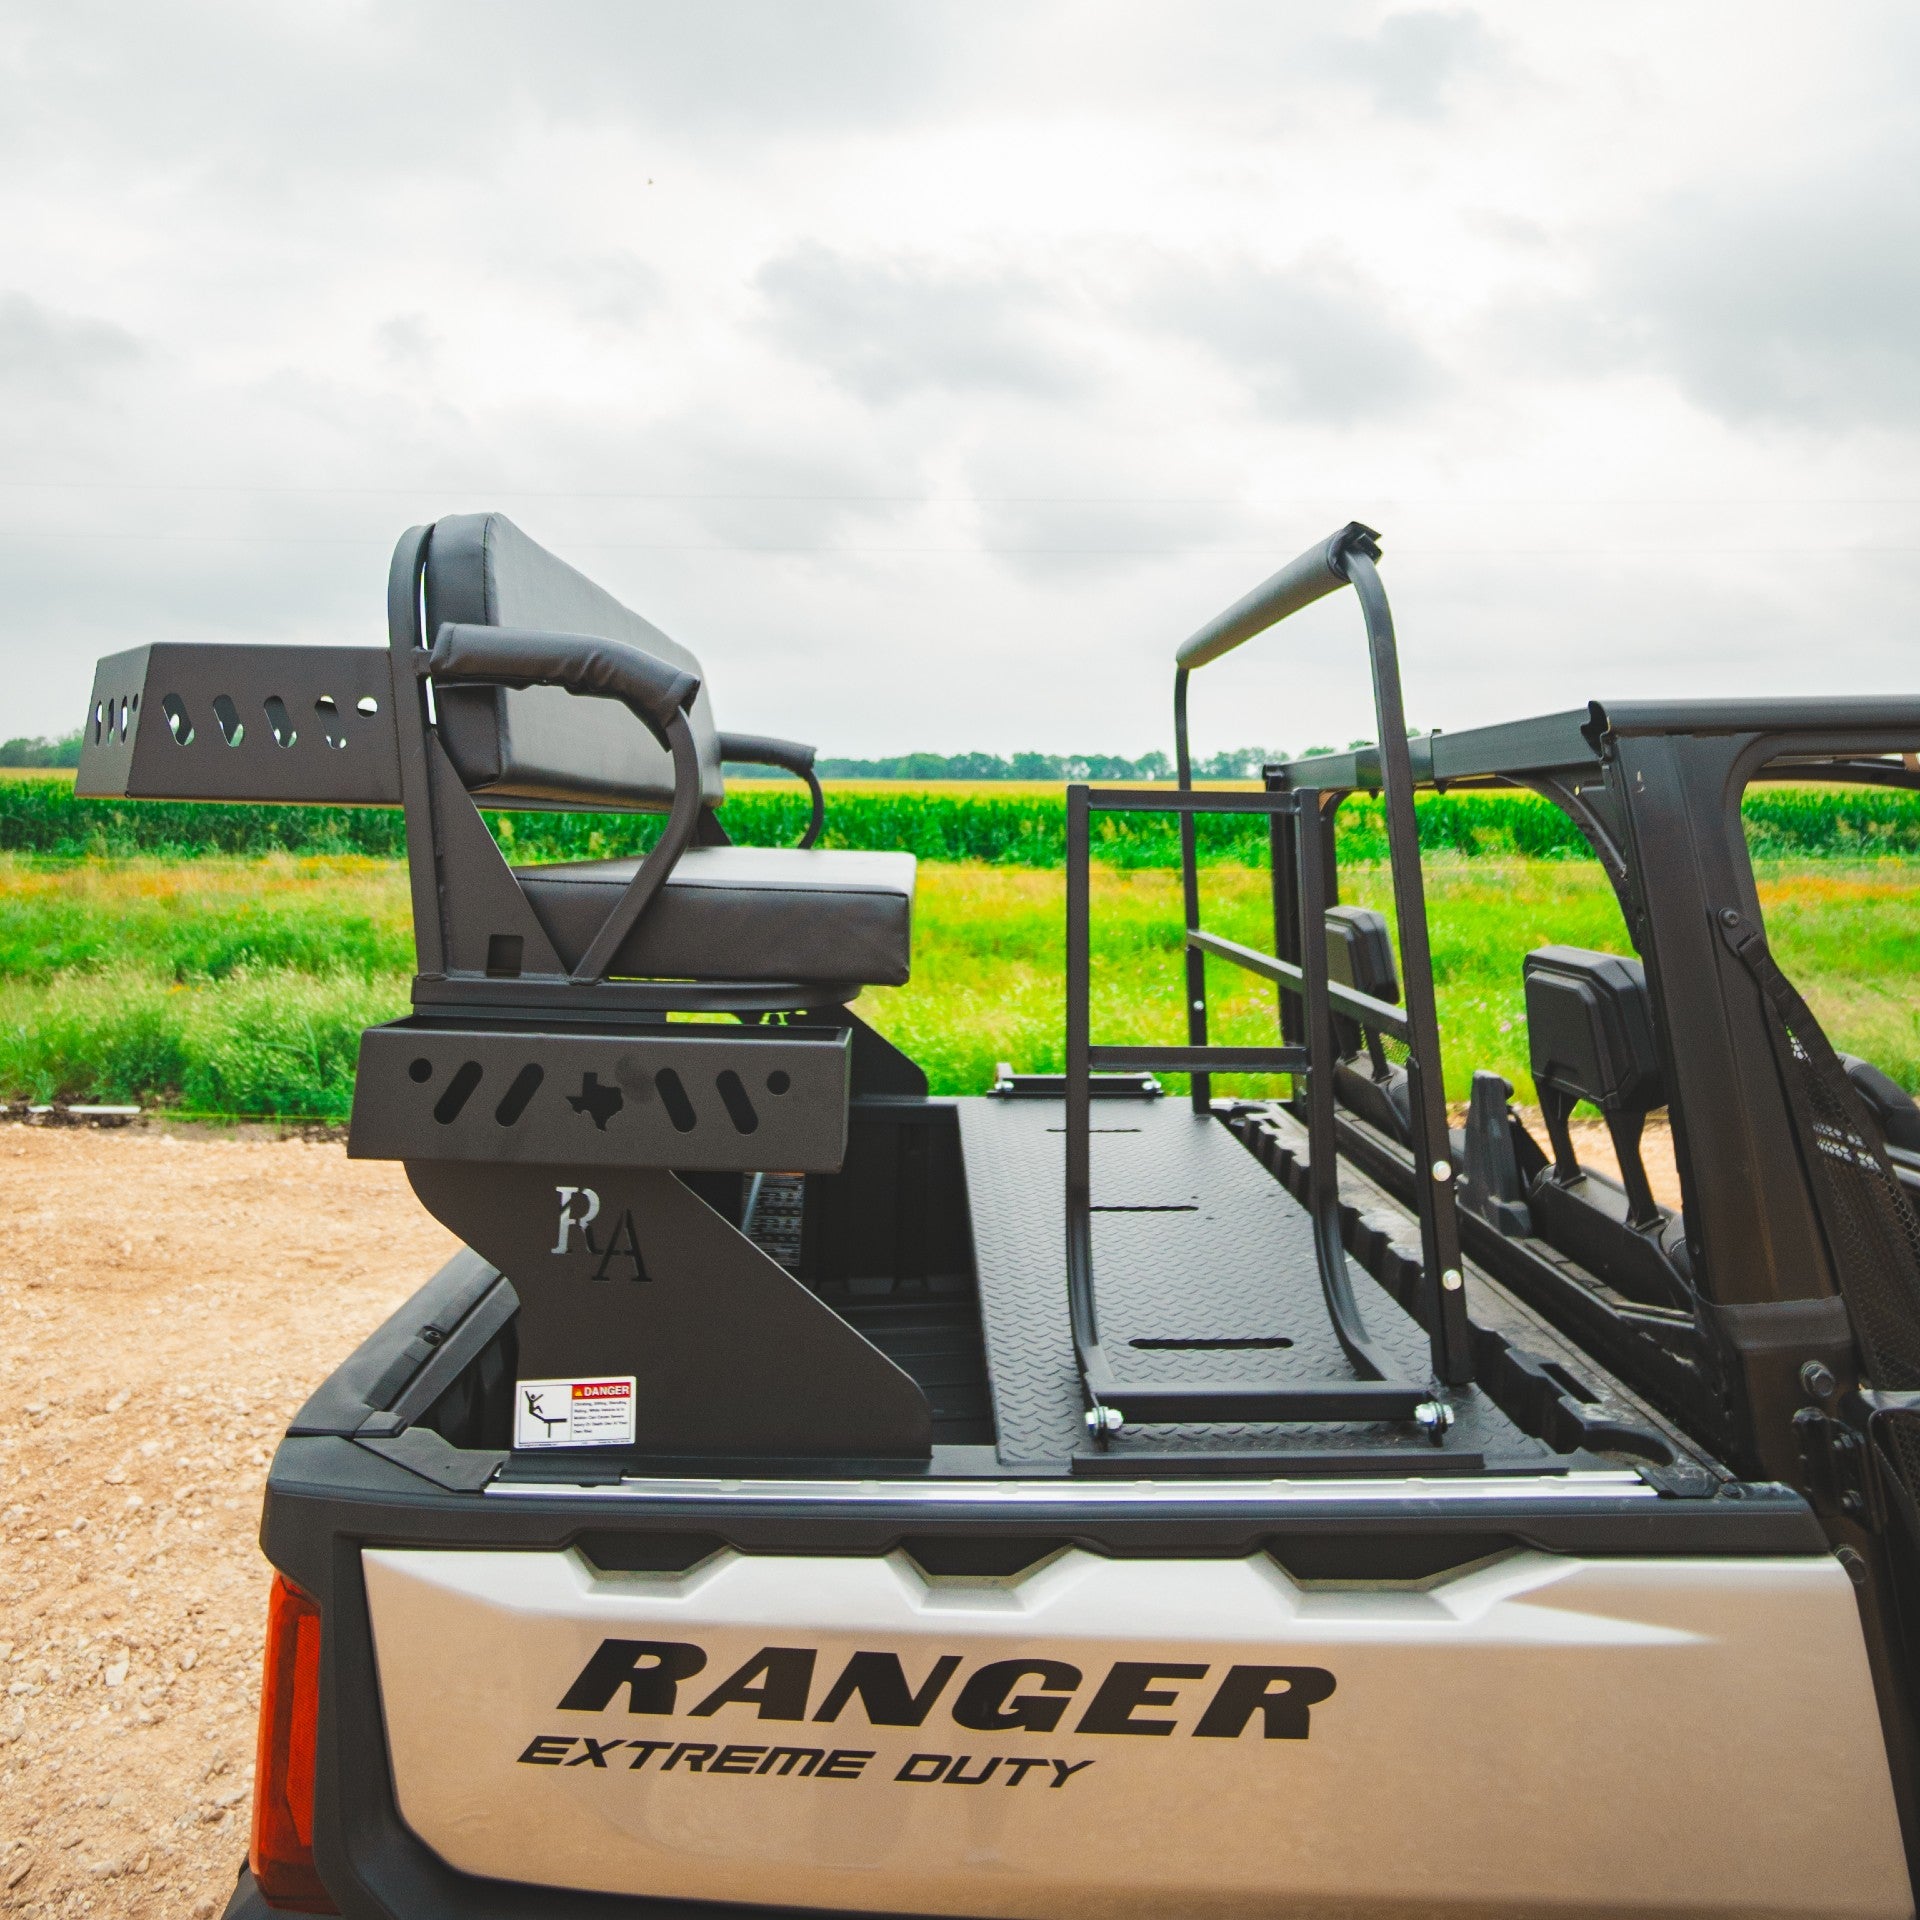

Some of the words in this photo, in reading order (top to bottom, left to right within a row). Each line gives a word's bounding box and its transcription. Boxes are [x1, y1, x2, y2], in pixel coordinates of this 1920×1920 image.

[583, 1385, 630, 1397] DANGER
[556, 1638, 1336, 1740] RANGER
[516, 1735, 877, 1780] EXTREME
[893, 1753, 1096, 1789] DUTY
